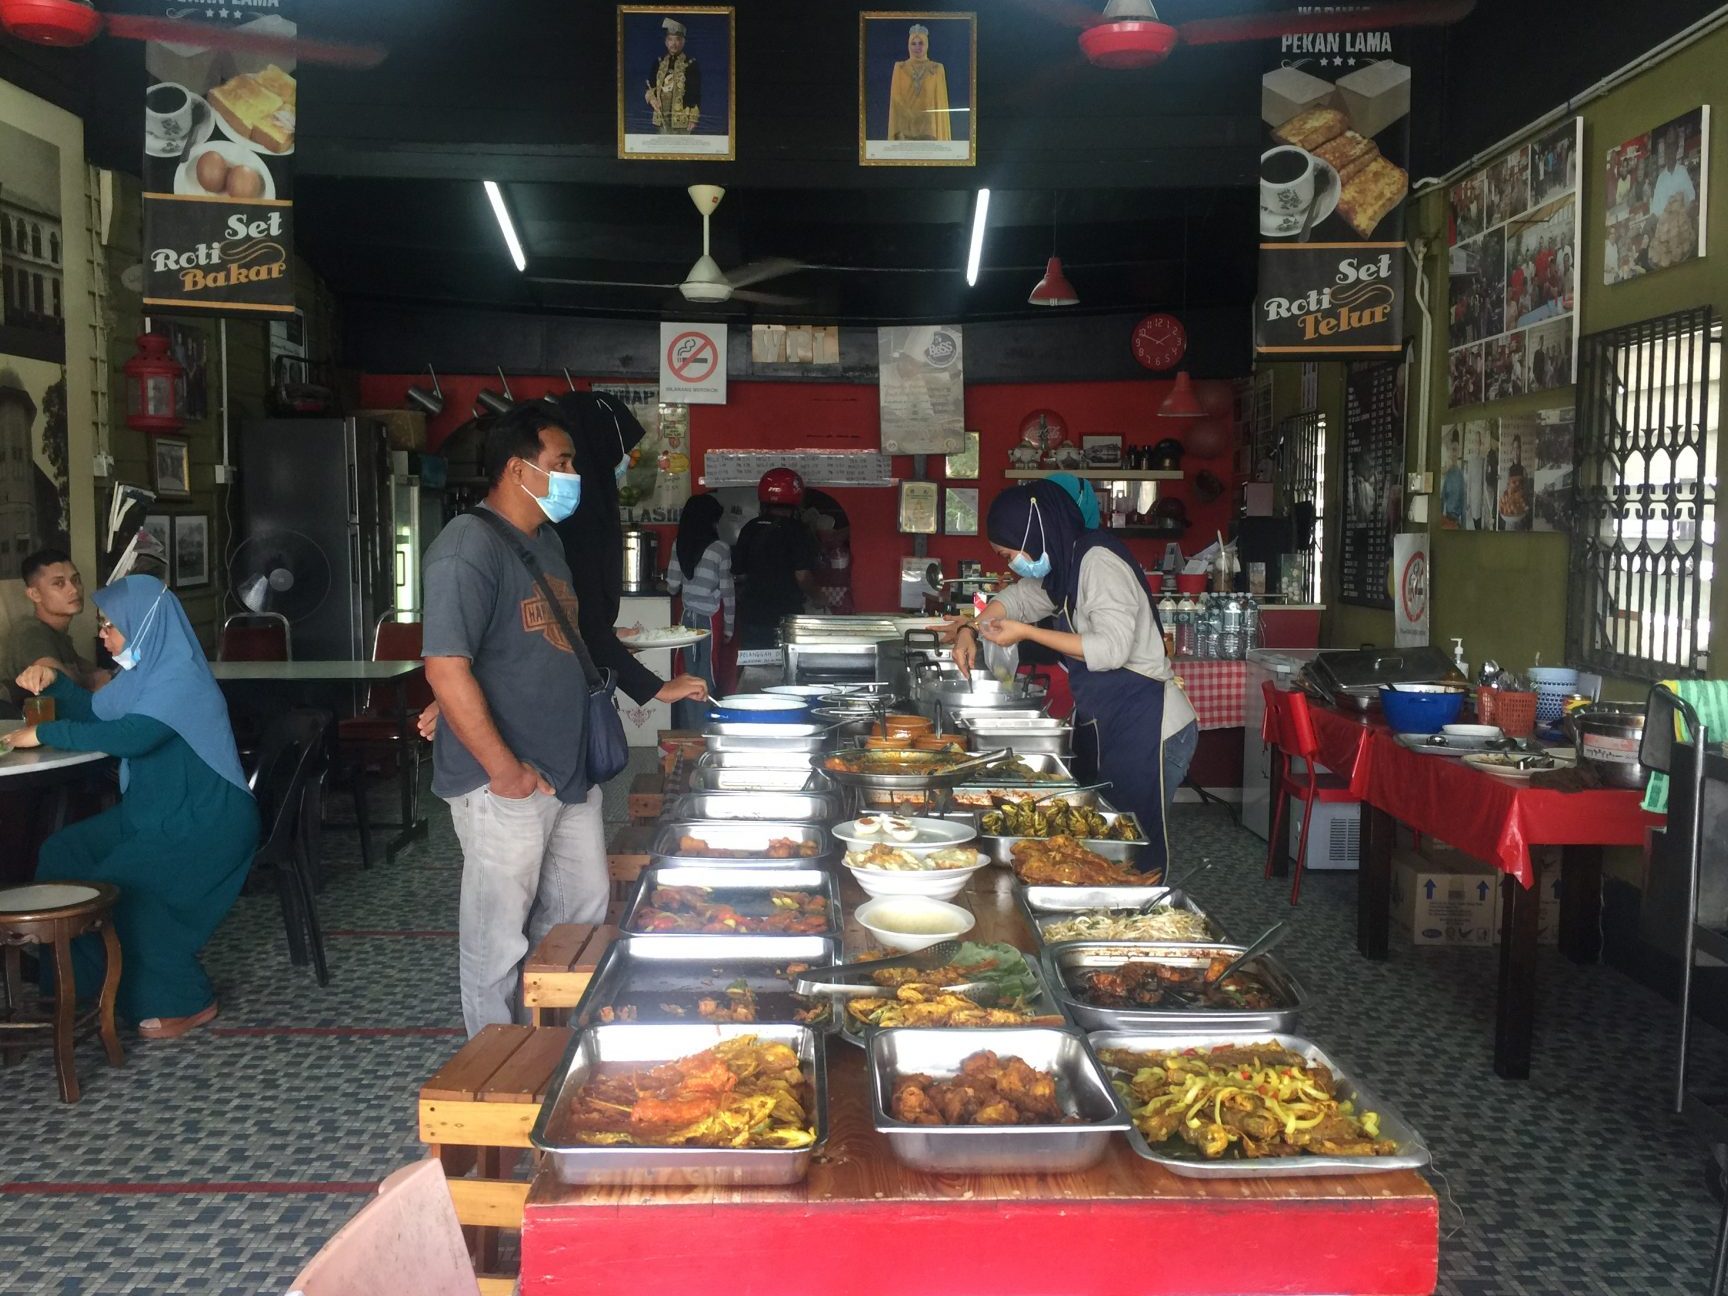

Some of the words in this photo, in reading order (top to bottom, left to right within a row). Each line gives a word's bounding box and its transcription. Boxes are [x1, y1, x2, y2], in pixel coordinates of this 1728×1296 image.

[1281, 32, 1340, 53] PEKAN
[1345, 31, 1392, 52] LAMA
[225, 211, 282, 240] Set
[151, 242, 221, 272] Roti
[1336, 254, 1392, 284] Set
[180, 262, 286, 291] Bakar
[1264, 287, 1332, 321] Roti
[1154, 318, 1164, 328] 12
[1298, 304, 1391, 340] Telur
[1135, 338, 1141, 348] 9
[1176, 337, 1182, 347] 3
[1138, 347, 1145, 357] 8
[1171, 347, 1178, 356] 4
[1145, 354, 1151, 364] 7
[1155, 356, 1161, 366] 6
[1164, 353, 1171, 363] 5
